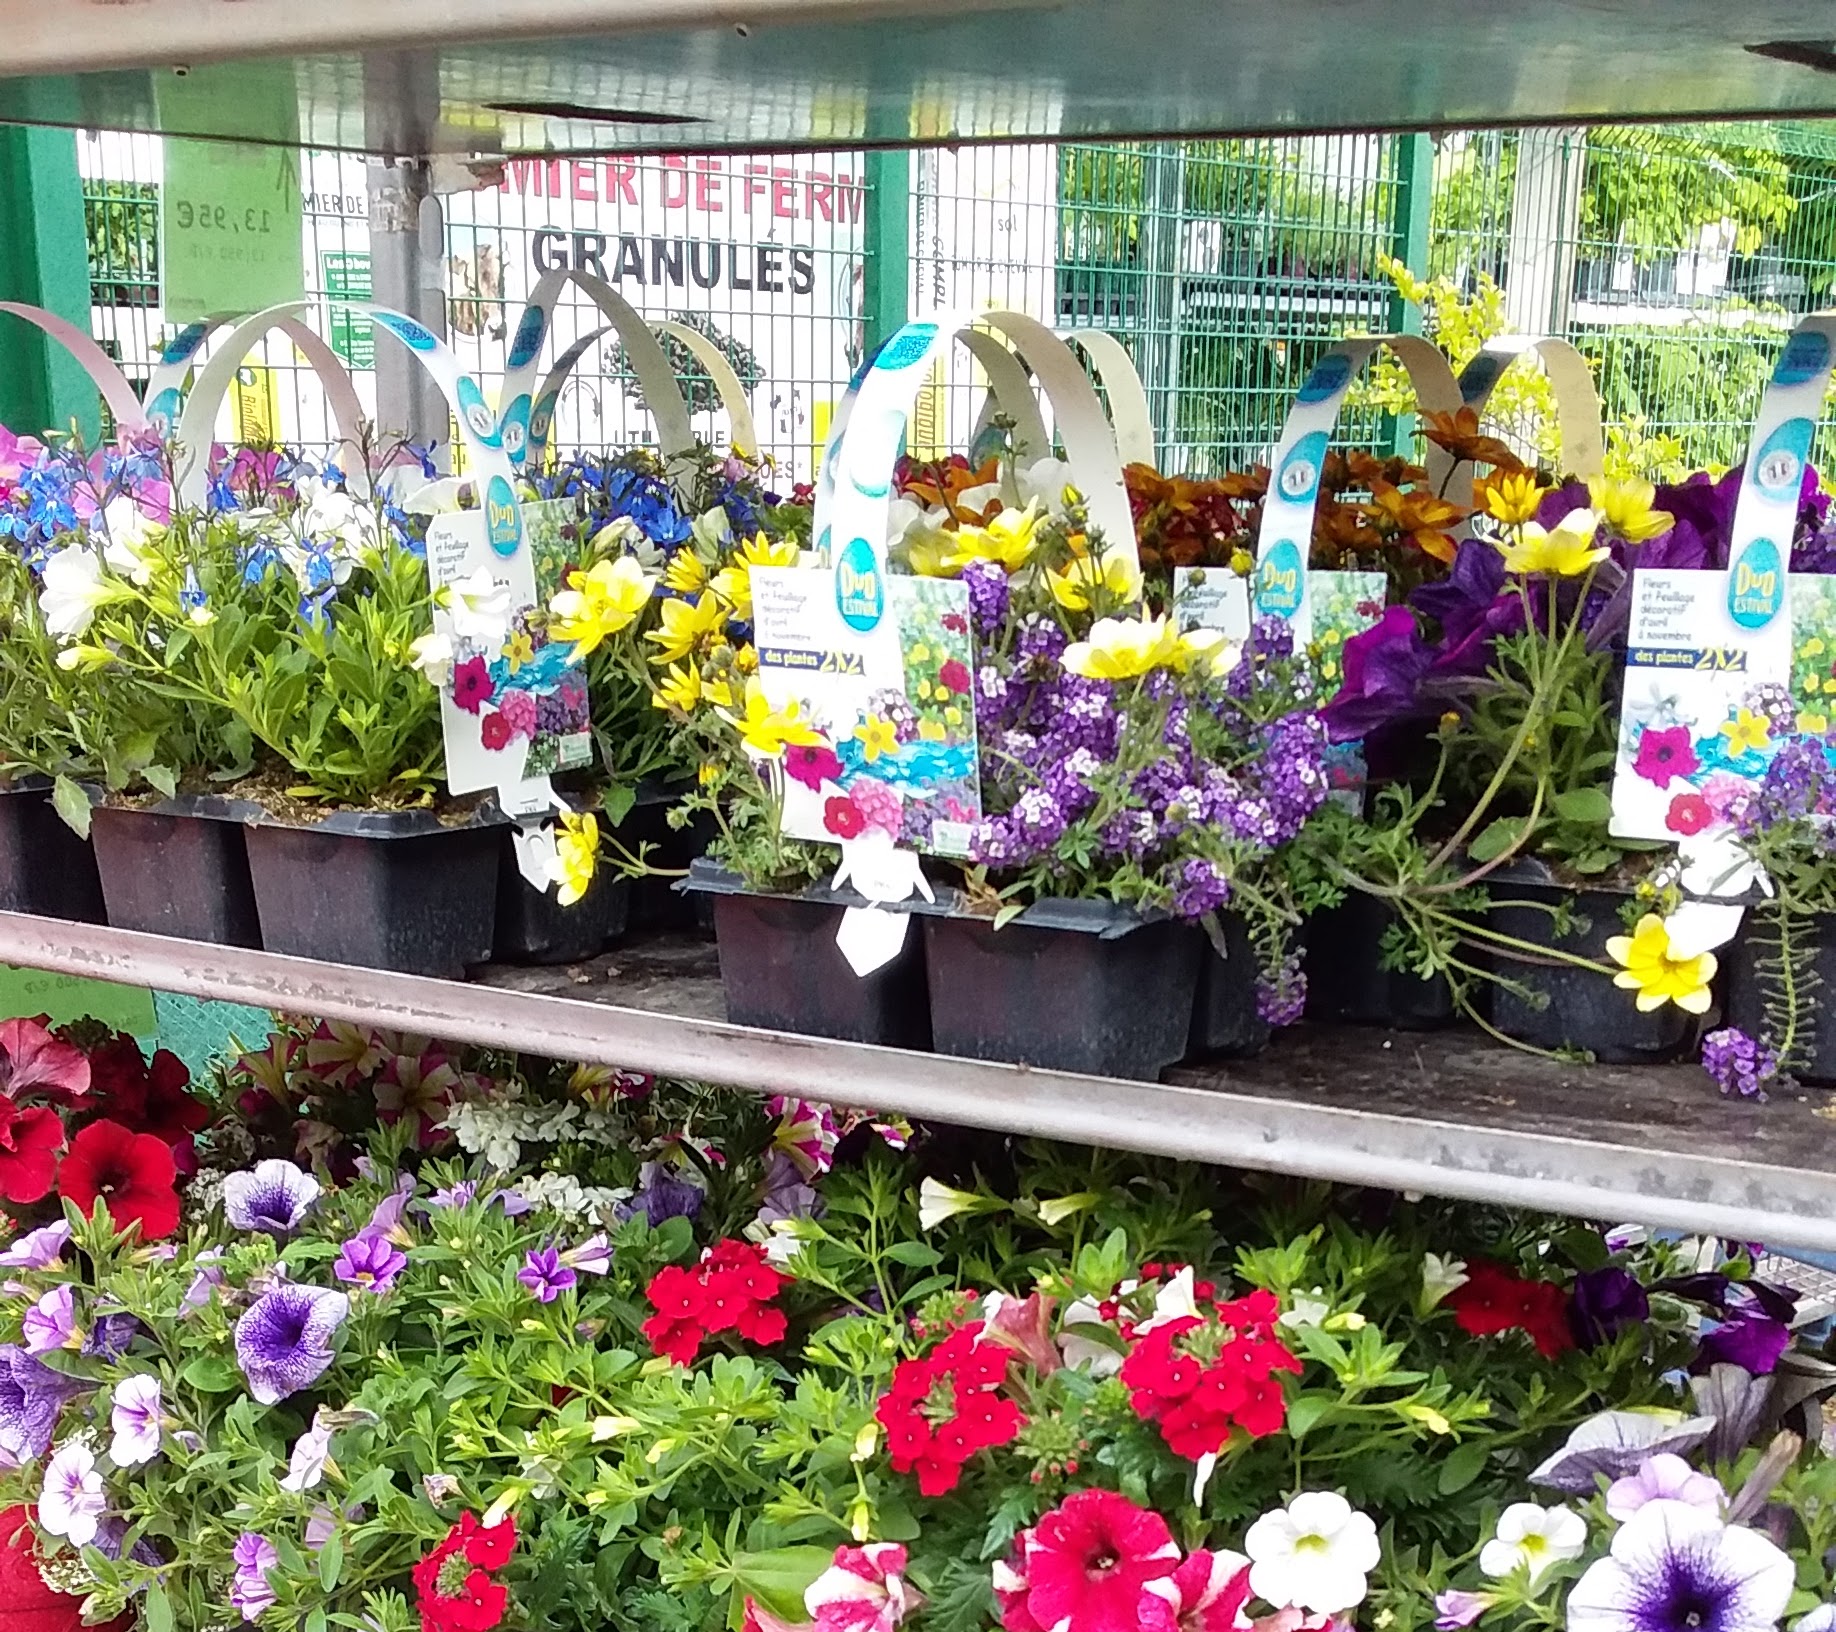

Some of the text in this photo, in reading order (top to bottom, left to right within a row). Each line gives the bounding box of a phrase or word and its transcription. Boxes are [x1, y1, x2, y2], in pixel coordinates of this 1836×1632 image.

[659, 157, 723, 213] DE
[743, 163, 864, 224] FERM
[302, 192, 364, 215] MIER DE
[532, 225, 815, 294] GRANULÉS
[1647, 633, 1692, 641] novembre
[784, 651, 818, 667] plantes
[1635, 651, 1653, 663] des
[1656, 653, 1693, 665] plantes
